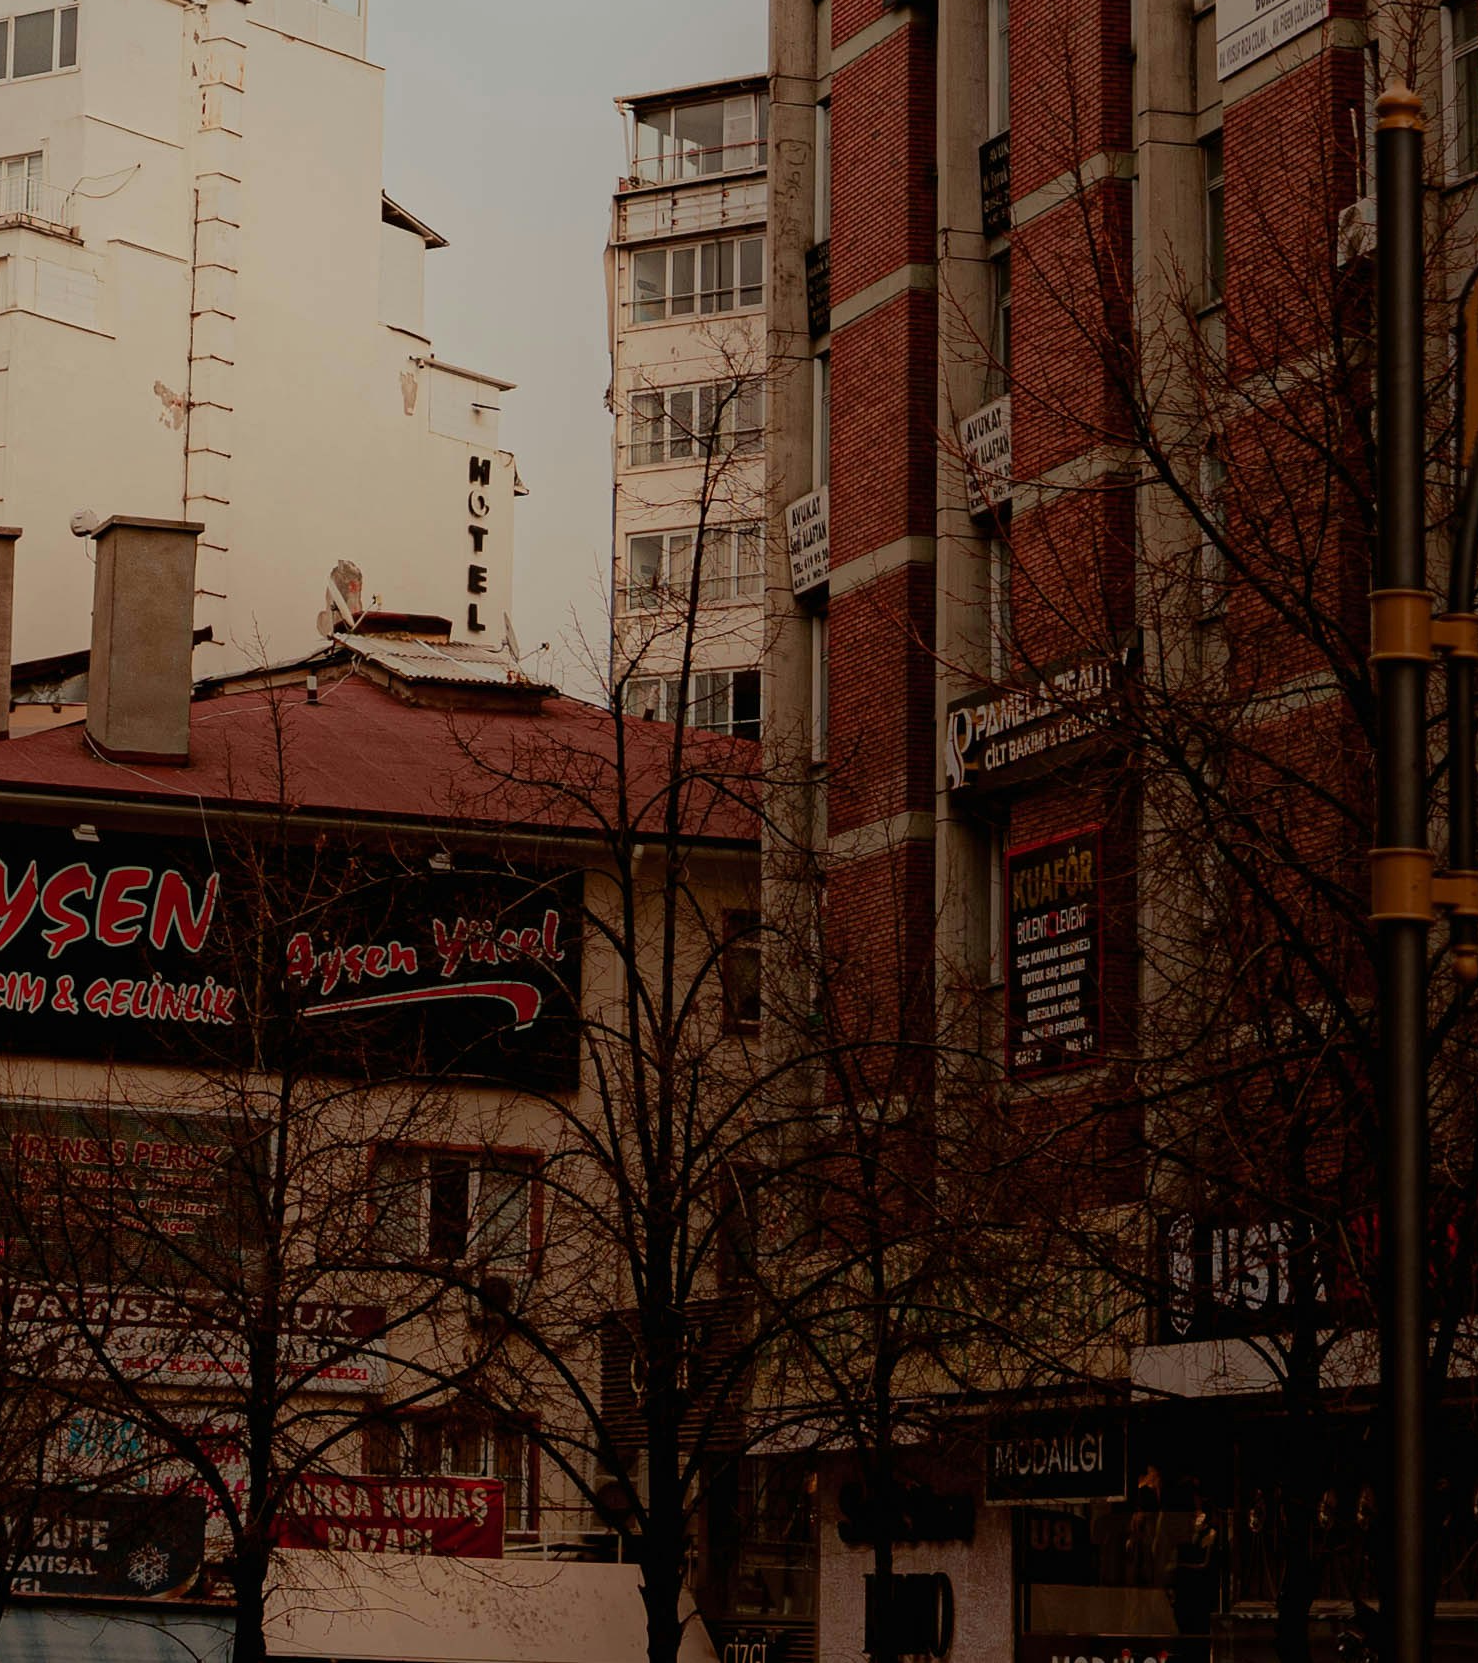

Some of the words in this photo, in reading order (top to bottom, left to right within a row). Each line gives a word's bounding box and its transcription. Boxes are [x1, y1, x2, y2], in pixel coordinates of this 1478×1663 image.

[966, 406, 1002, 444] AVUKAT
[791, 495, 821, 529] AVUKAT
[467, 453, 491, 634] HOTEL
[1012, 845, 1093, 913] KUAFÖR
[285, 930, 420, 996] Ayşen
[431, 907, 565, 979] Yücel
[50, 974, 79, 1015] &
[83, 970, 237, 1026] GELİNLİK
[380, 1484, 489, 1528] KUMAŞ
